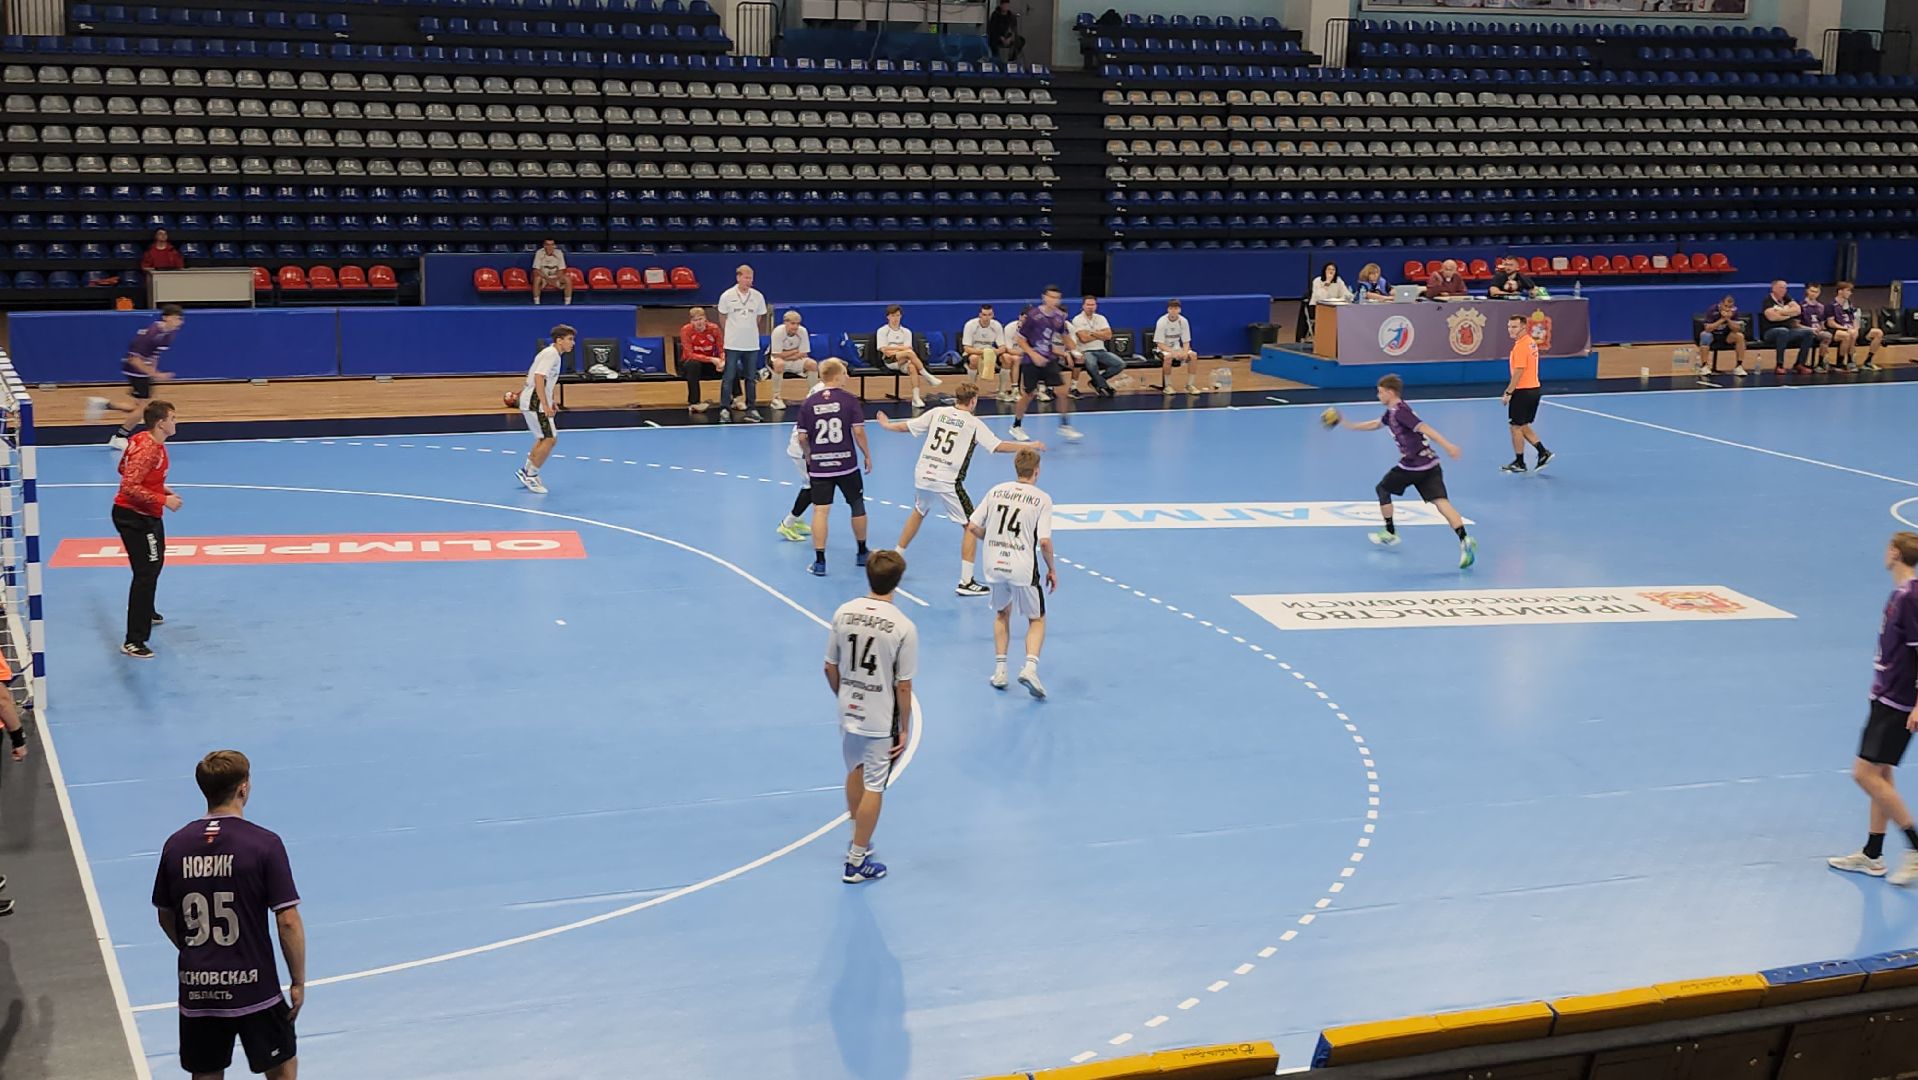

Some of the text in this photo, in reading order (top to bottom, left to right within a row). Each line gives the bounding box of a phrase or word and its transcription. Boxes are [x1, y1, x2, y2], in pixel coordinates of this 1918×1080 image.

[815, 418, 843, 444] 28
[930, 427, 958, 454] 55
[997, 504, 1021, 537] 74
[1052, 508, 1310, 523] АГМА
[78, 539, 561, 559] OLIMPBET
[1281, 599, 1417, 608] ОБЛАСТИ
[1296, 604, 1650, 621] ПРАВИТЕЛЬСТВО
[848, 633, 876, 676] 14
[182, 855, 234, 879] НОВИК
[182, 892, 239, 946] 95
[180, 969, 258, 985] ОСКОВСКАЯ
[189, 990, 233, 1000] ОБЛАСТЬ
